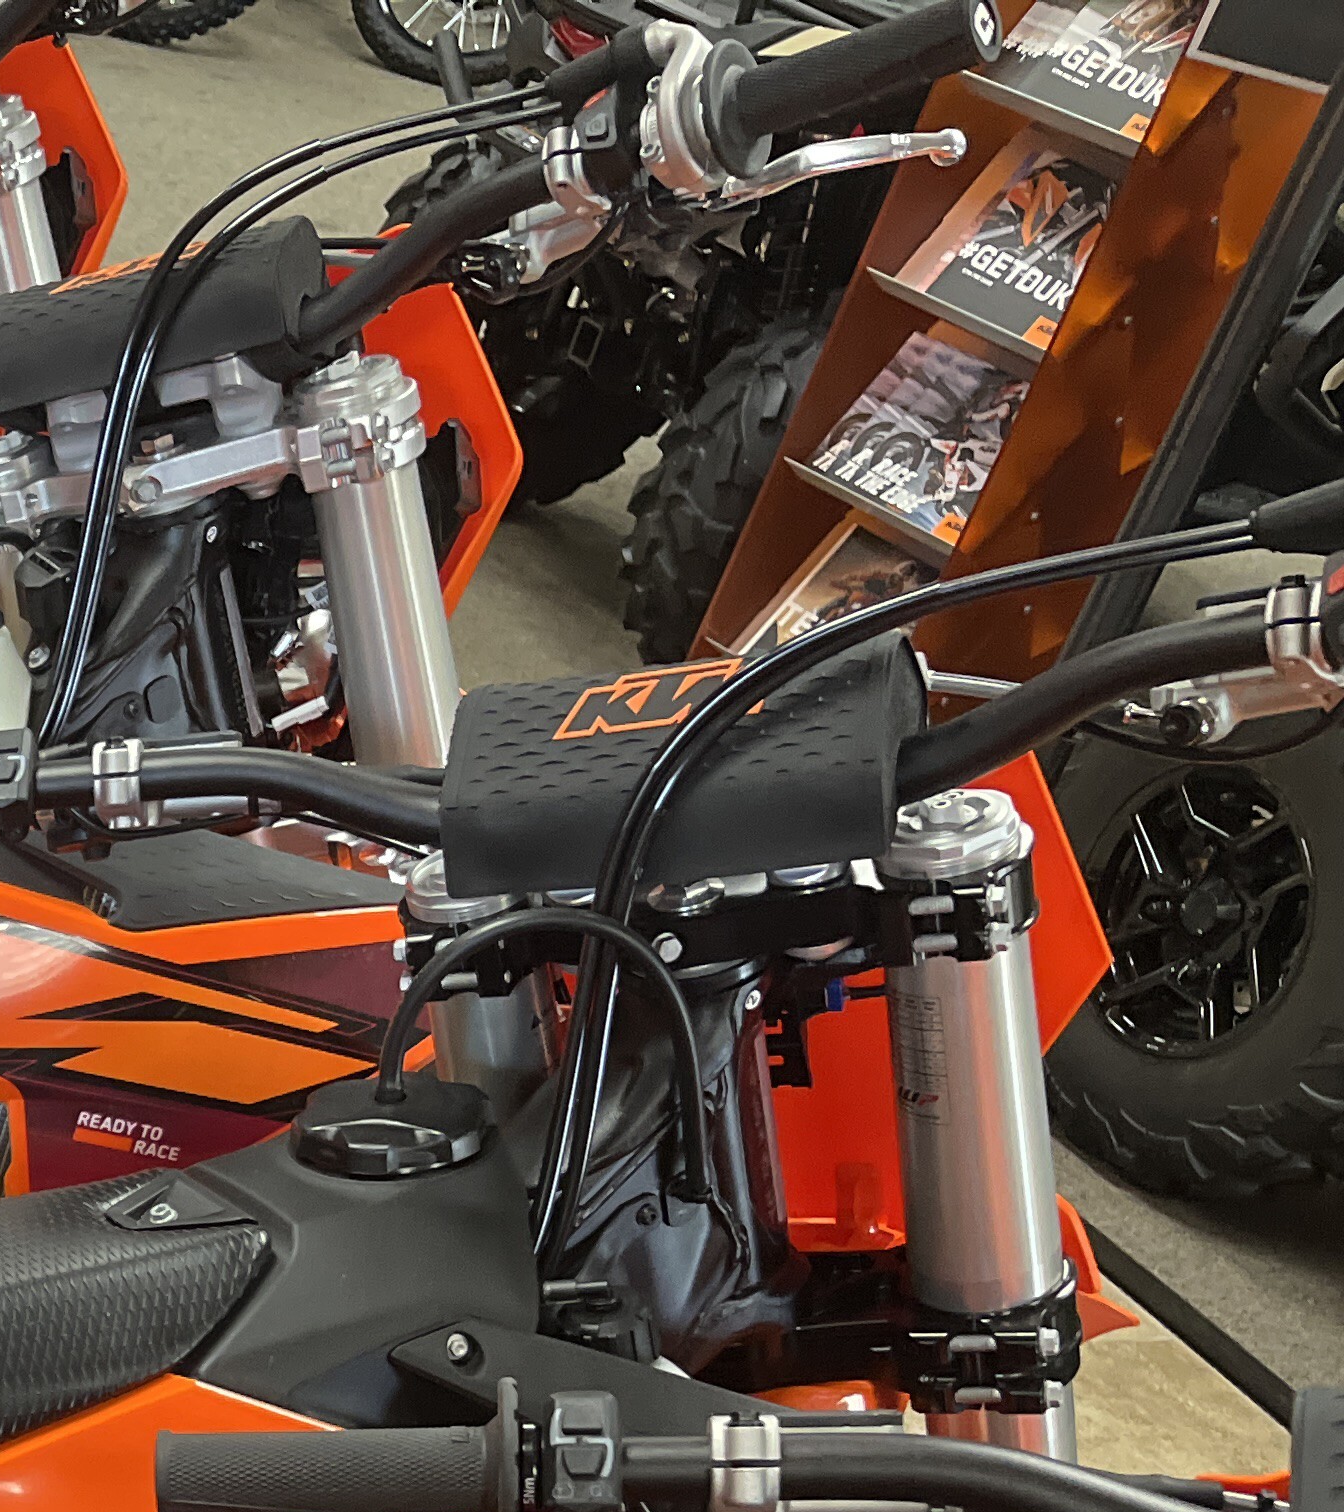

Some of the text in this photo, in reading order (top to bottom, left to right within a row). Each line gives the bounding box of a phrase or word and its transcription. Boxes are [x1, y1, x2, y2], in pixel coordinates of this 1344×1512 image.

[76, 1111, 164, 1141] READY TO
[133, 1140, 181, 1162] RACE
